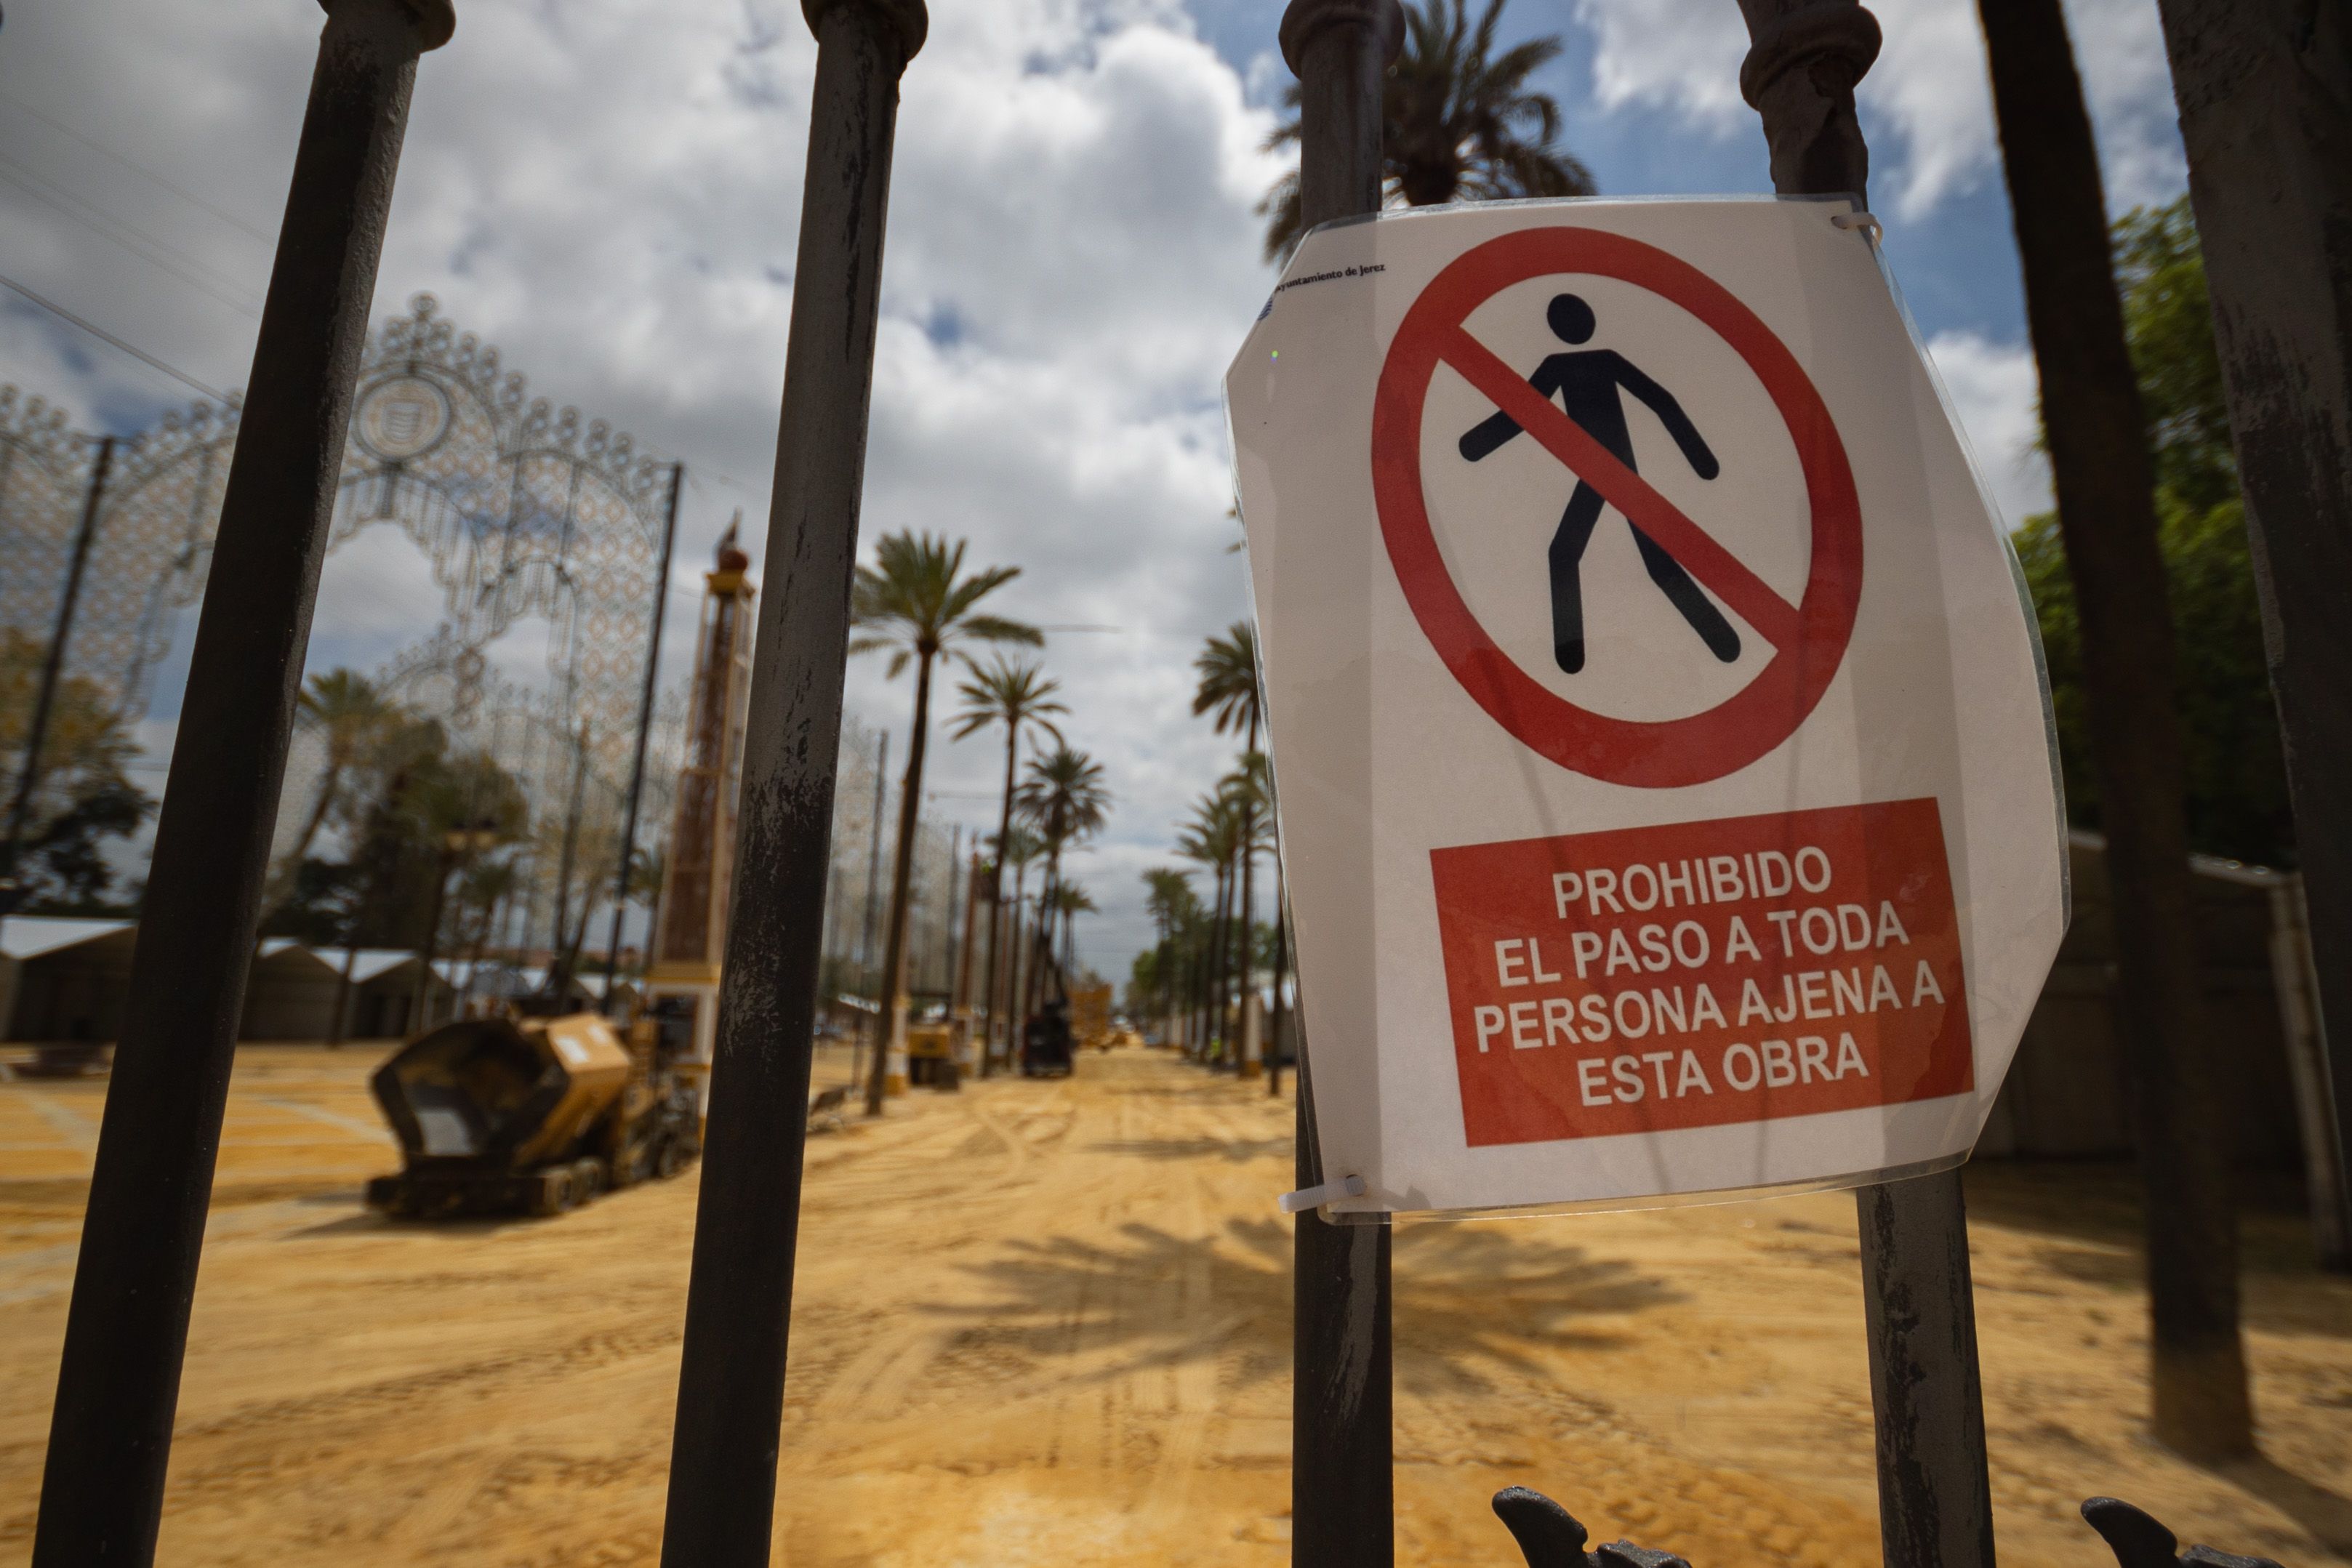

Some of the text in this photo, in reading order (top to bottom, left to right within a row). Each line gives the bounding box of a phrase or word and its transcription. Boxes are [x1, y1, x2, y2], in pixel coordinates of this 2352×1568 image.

[1345, 267, 1357, 277] de
[1359, 264, 1386, 277] Jerez
[1553, 846, 1831, 919] PROHIBIDO
[1495, 900, 1910, 987] EL PASO A TODA
[1474, 959, 1945, 1053] PERSONA AJENA A
[1577, 1032, 1869, 1107] ESTA OBRA
